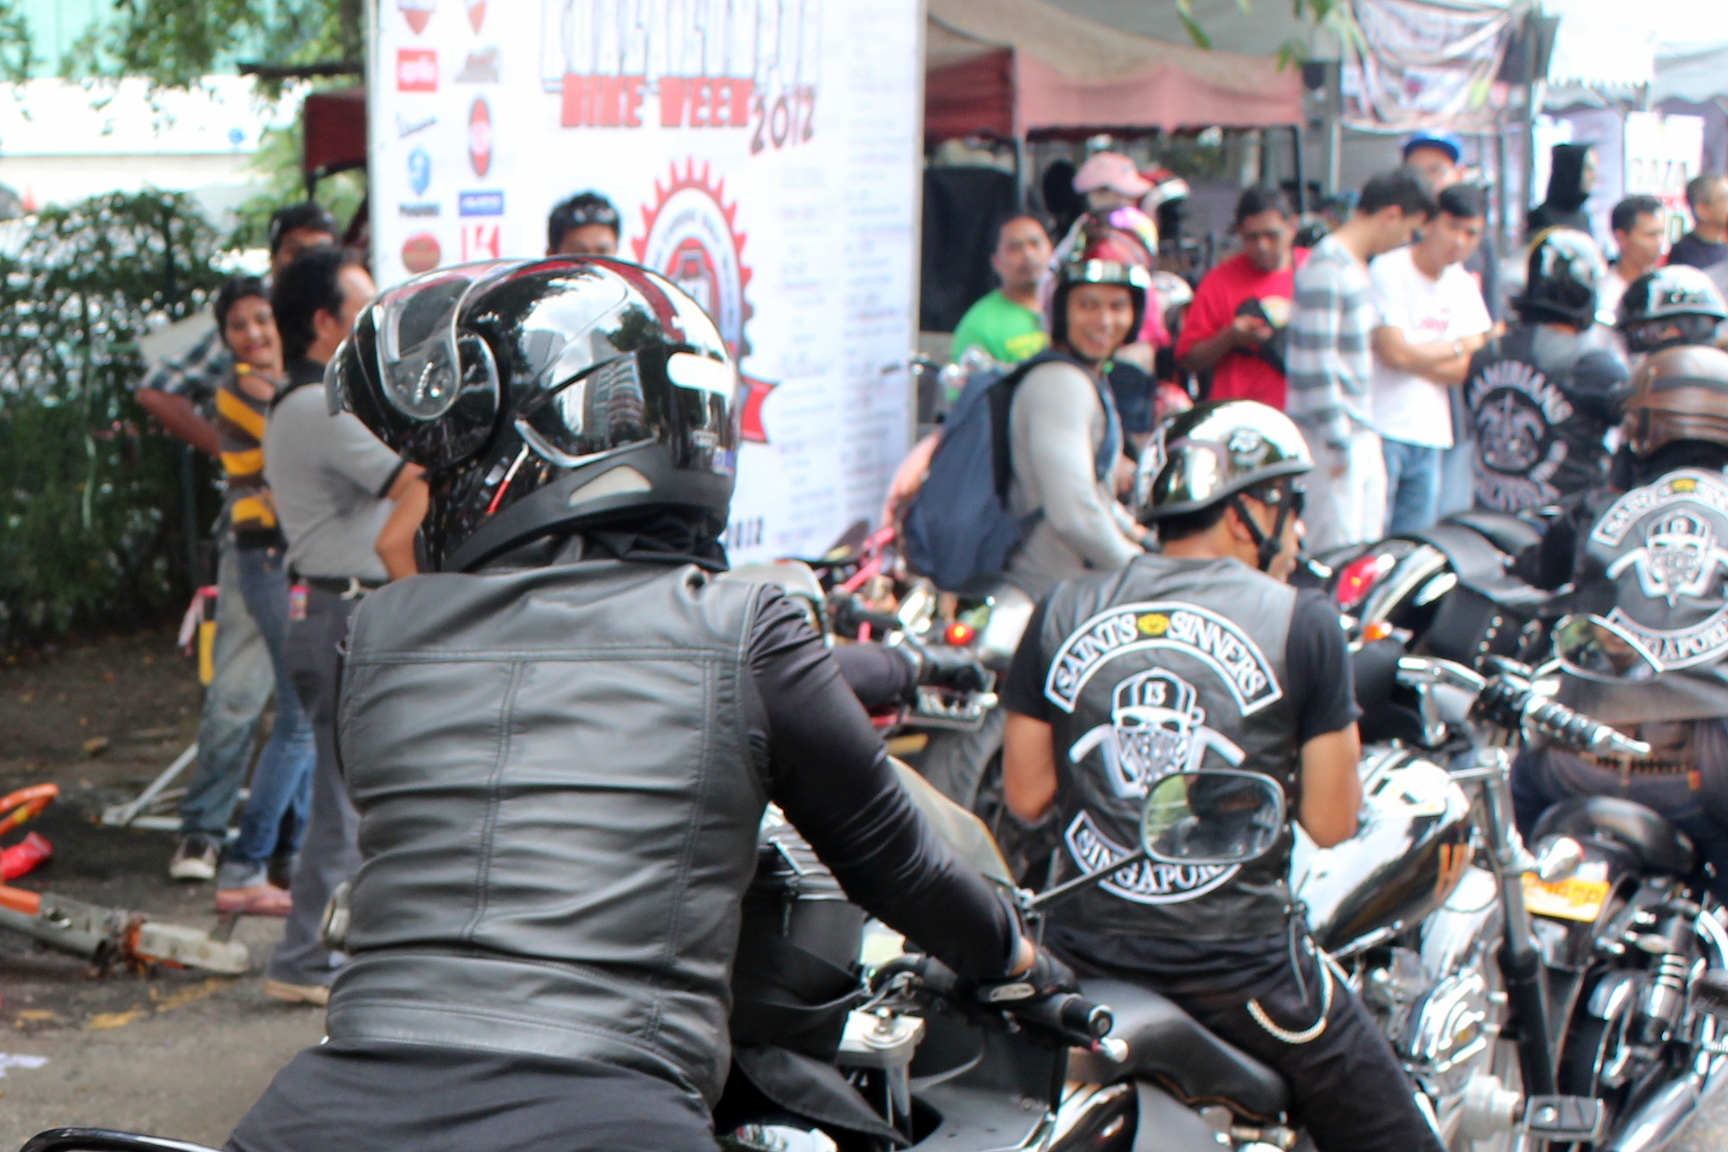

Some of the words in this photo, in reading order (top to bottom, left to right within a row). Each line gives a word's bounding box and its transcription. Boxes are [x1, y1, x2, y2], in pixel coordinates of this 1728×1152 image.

[560, 73, 646, 128] BIKE
[658, 76, 755, 128] WEEK
[749, 86, 816, 156] 2012
[1055, 612, 1138, 691] SAINTS
[1168, 611, 1268, 698] SINNERS
